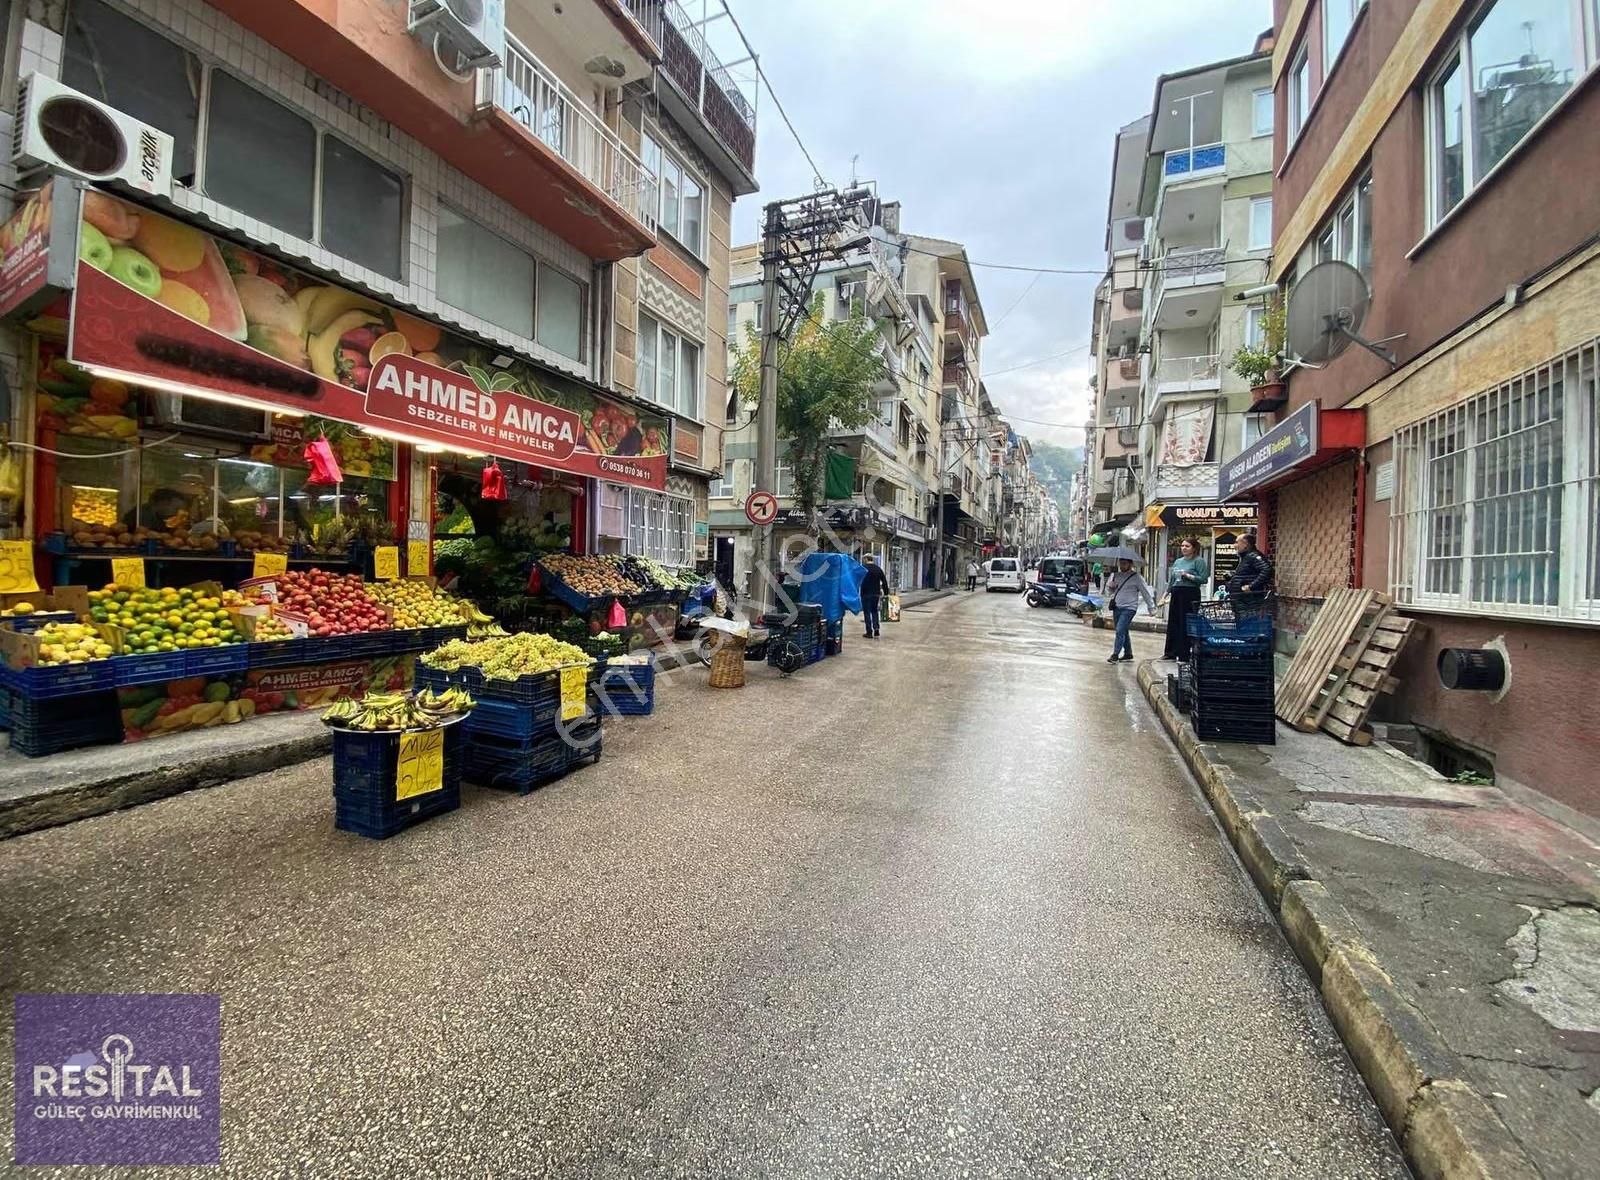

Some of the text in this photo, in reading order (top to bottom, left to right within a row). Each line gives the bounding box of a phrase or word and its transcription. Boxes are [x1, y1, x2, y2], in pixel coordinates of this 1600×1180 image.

[375, 363, 498, 421] AHMED
[502, 404, 574, 444] AMCA
[270, 425, 302, 440] MCA
[407, 404, 555, 451] SEBZELER VE MEYVELER
[1176, 507, 1254, 518] UMUT YAPI
[260, 667, 364, 684] AHMED AMCA
[401, 732, 440, 754] MUZ
